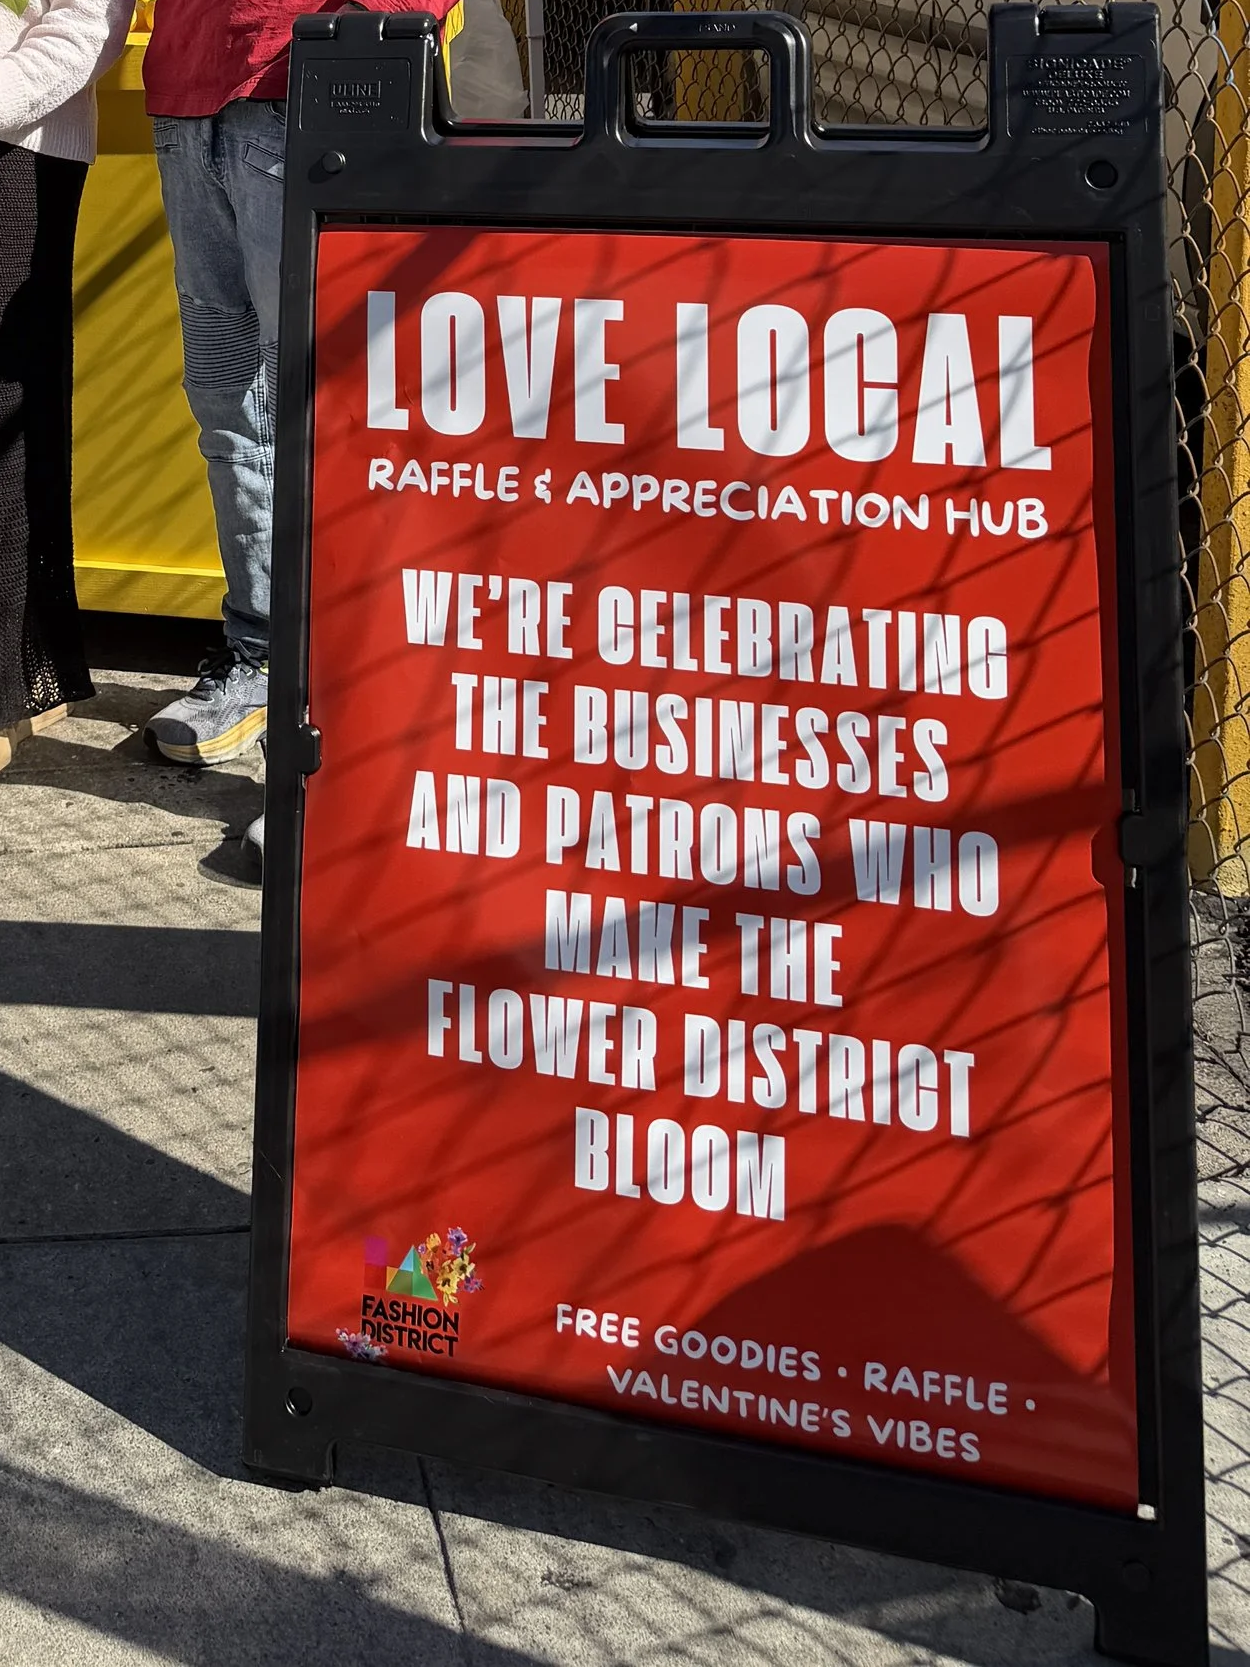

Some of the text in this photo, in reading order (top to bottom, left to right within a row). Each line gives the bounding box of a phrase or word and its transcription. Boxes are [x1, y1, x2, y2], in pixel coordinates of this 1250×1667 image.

[332, 83, 378, 97] ULINE
[367, 291, 1052, 470] LOVE LOCAL
[369, 458, 1048, 539] RAFFLE & APPRECIATION HUB
[402, 568, 1008, 699] WE'RE CELEBRATING
[451, 672, 949, 802] THE BUSINESSES
[406, 770, 999, 916] AND PATRONS WHO
[545, 889, 842, 1007] MAKE THE
[428, 979, 974, 1137] FLOWER DISTRICT
[575, 1107, 785, 1221] BLOOM
[361, 1295, 459, 1334] FASHION
[361, 1319, 458, 1357] DISTRICT
[557, 1304, 1007, 1415] FREE GOODIES RAFFLE
[607, 1365, 980, 1462] VALENTINE'S VIBES
